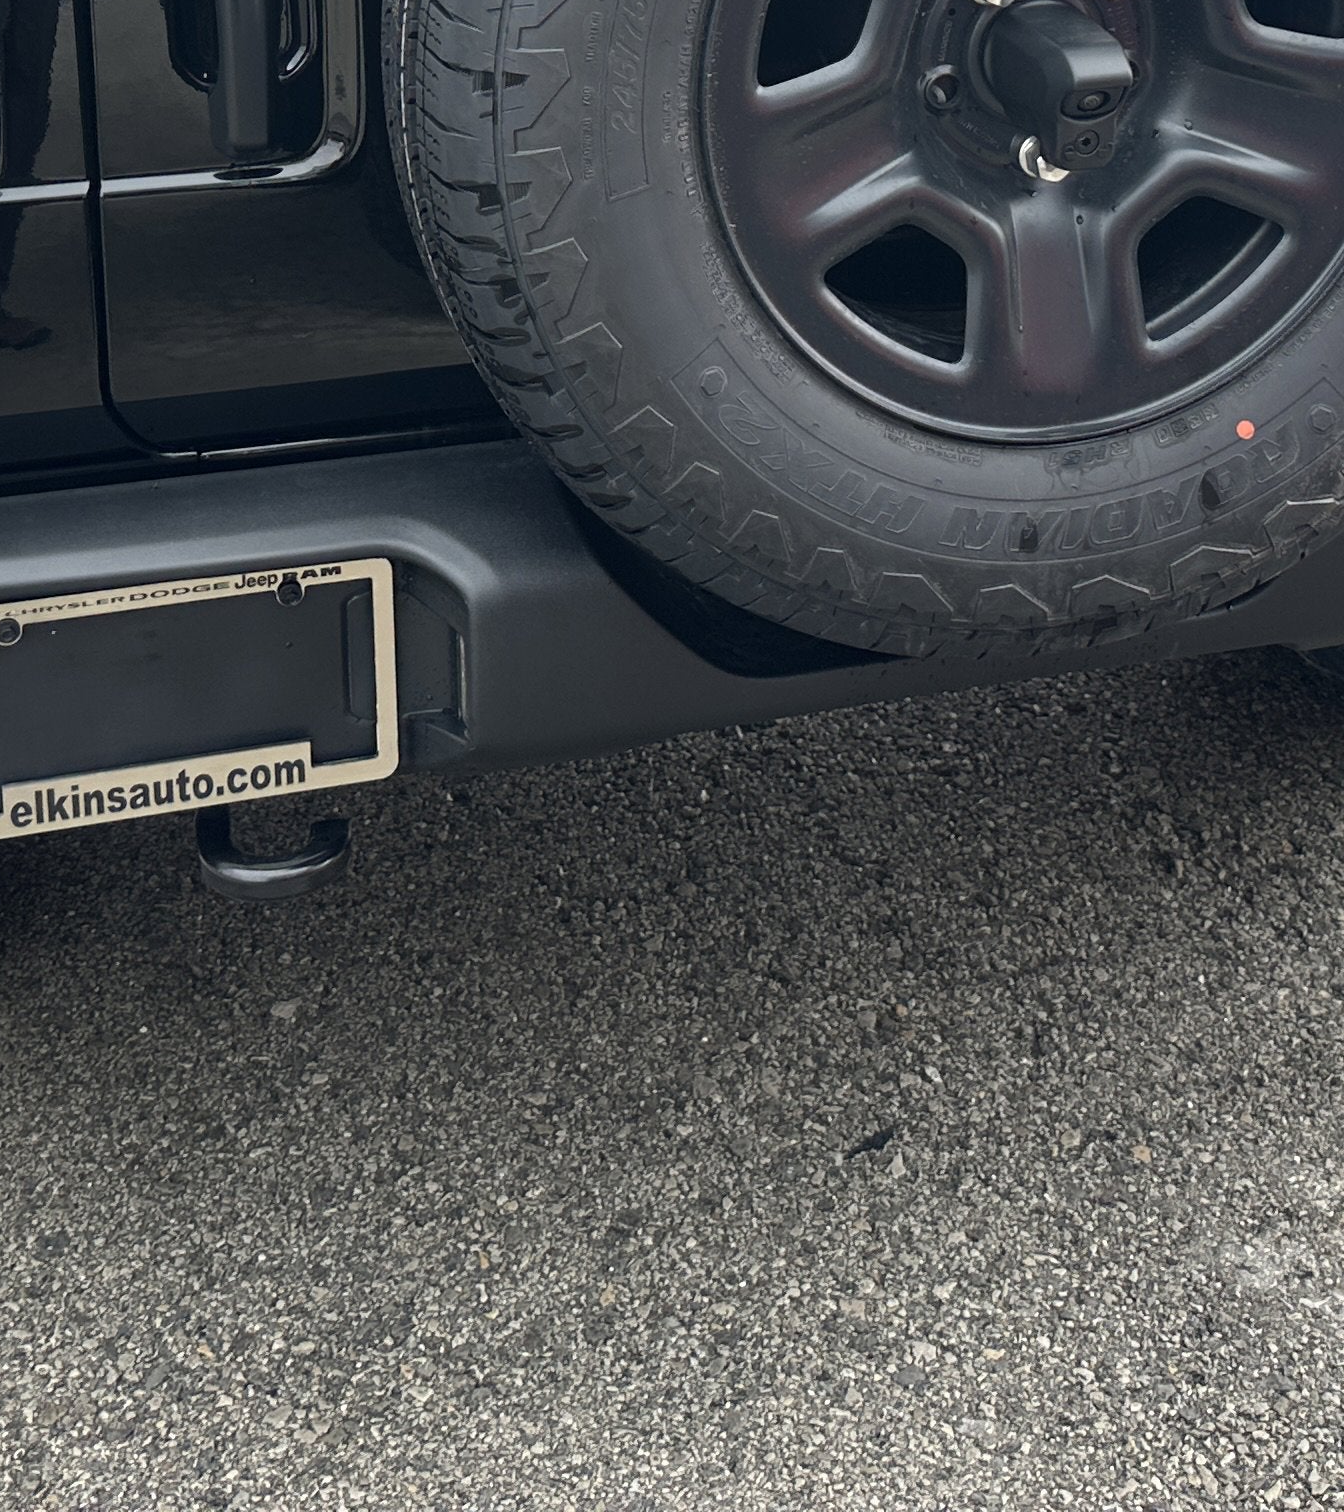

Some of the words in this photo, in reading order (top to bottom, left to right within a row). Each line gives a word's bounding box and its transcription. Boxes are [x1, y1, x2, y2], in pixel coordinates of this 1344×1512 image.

[936, 419, 1298, 554] ROADIAN
[4, 596, 125, 617] CHRYSLER
[129, 581, 231, 602] DODGE
[234, 573, 278, 590] Jeep
[281, 565, 342, 584] RAM
[9, 756, 307, 828] elkinsauto.com
